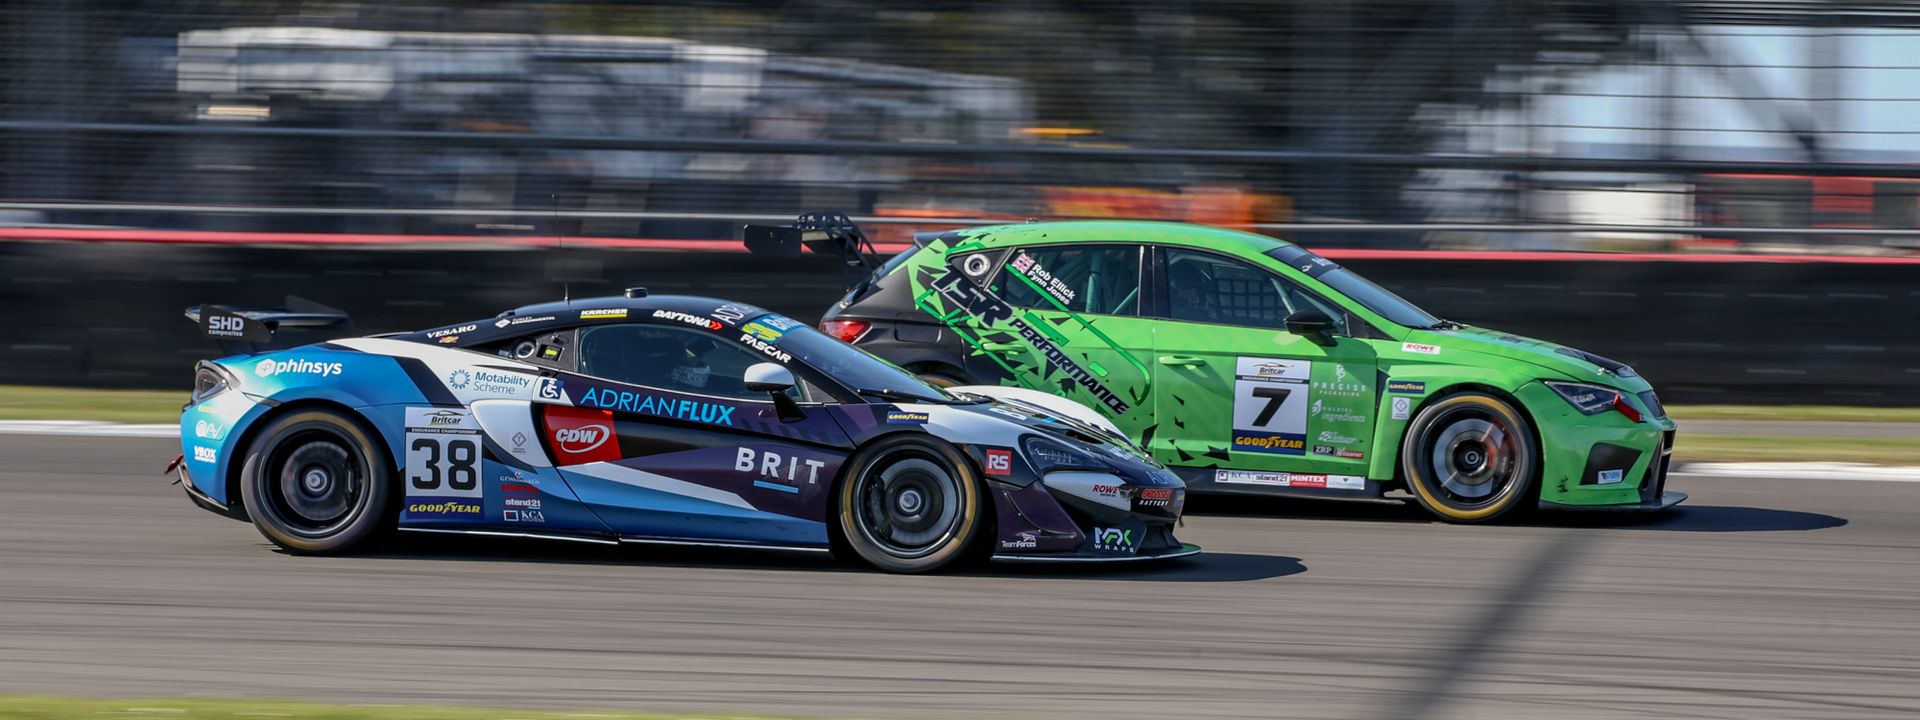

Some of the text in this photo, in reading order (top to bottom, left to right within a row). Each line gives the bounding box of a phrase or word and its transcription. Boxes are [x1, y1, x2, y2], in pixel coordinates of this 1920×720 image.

[1027, 270, 1070, 305] Fynn Jones
[1032, 263, 1075, 300] Rob Ellick
[208, 315, 245, 331] SHD
[652, 309, 712, 329] DAYTONA
[426, 323, 477, 339] VESARO
[740, 333, 792, 363] FASCAR
[1406, 343, 1435, 351] ROWE
[274, 358, 343, 377] phinsys
[1008, 318, 1130, 415] PERFORMANCE
[1259, 367, 1285, 375] Britcar
[475, 371, 530, 388] Motability
[1313, 382, 1367, 392] PRECISE
[473, 381, 516, 396] Scheme
[1252, 387, 1292, 427] 7
[431, 416, 461, 425] Britcar
[888, 413, 928, 421] GOODYEAR
[555, 428, 598, 444] CDW
[1235, 435, 1304, 449] GOODYEAR
[411, 438, 477, 490] 38
[735, 447, 825, 485] BRIT
[988, 454, 1009, 470] RS
[1291, 474, 1326, 483] MINTEX
[1092, 484, 1119, 494] ROWE
[409, 501, 481, 515] GOODYEAR
[521, 510, 544, 519] KCA
[1093, 543, 1135, 553] WRAPS
